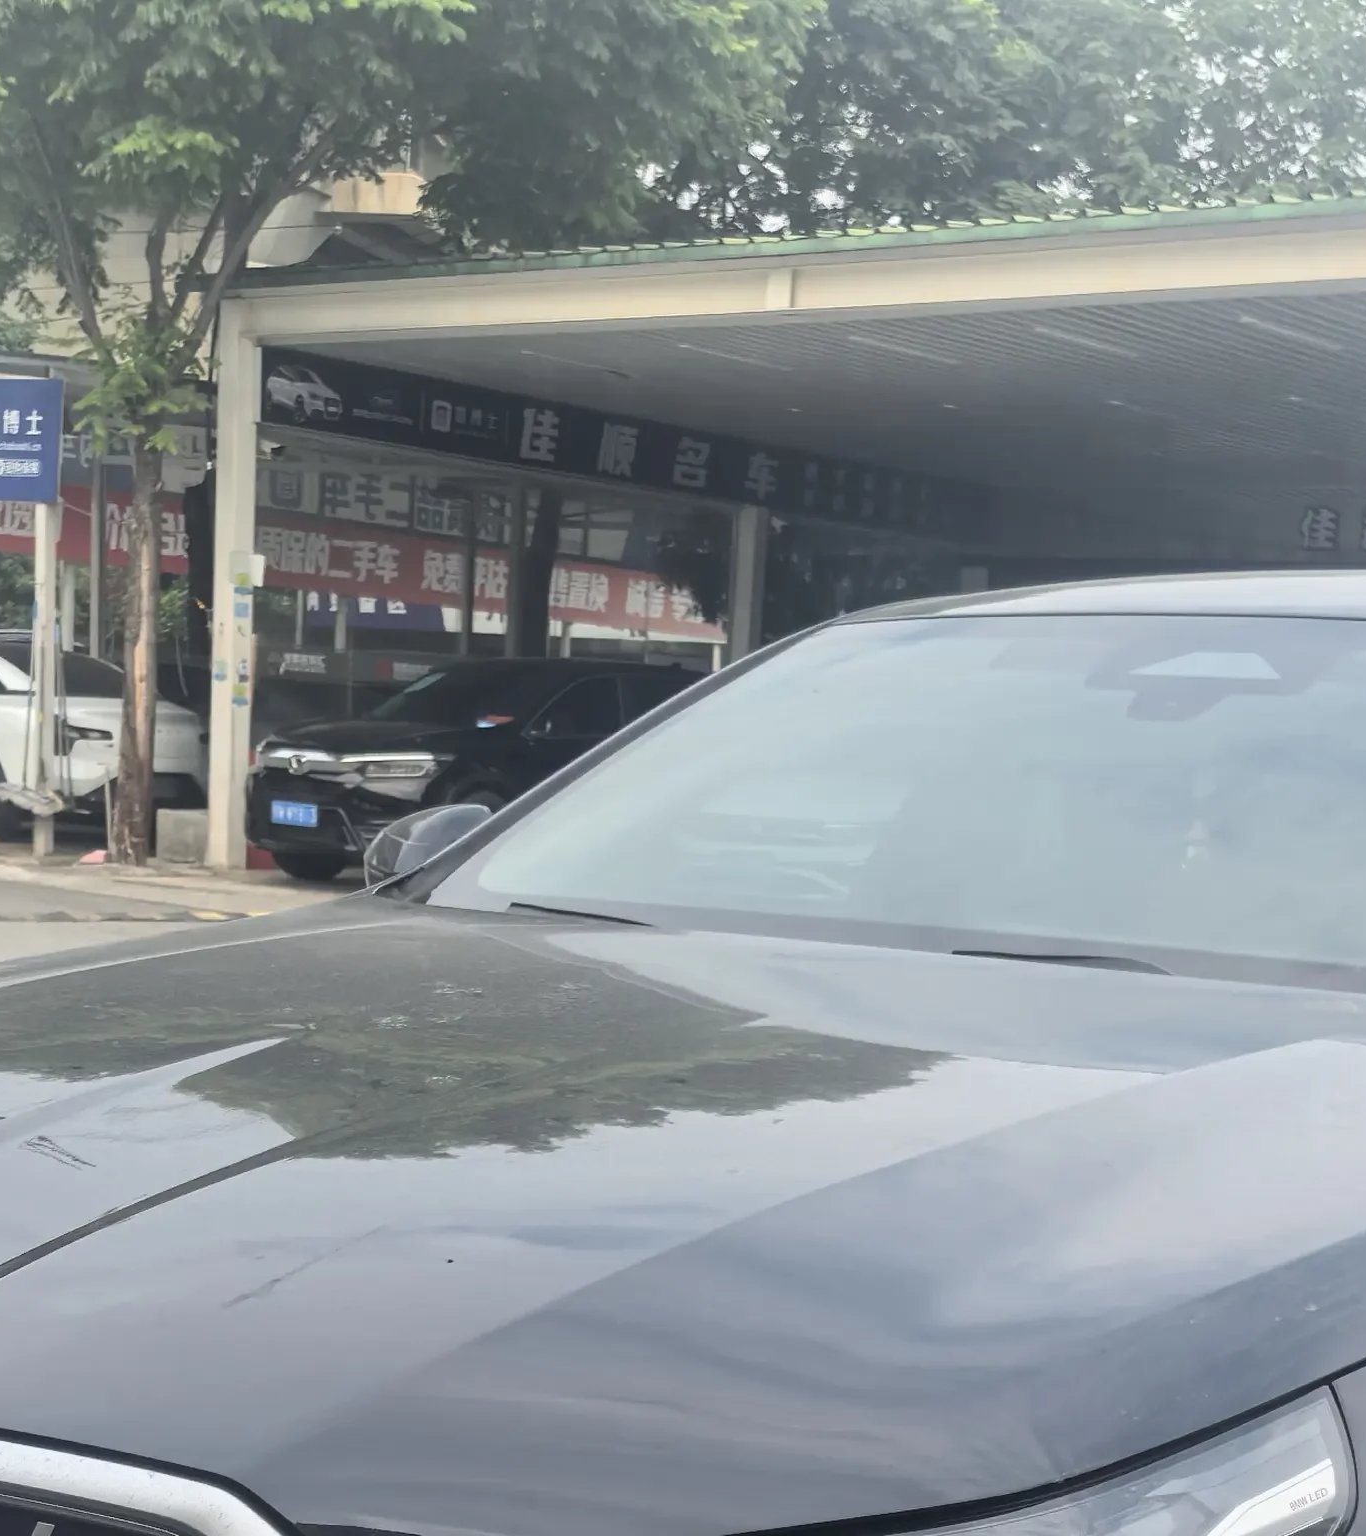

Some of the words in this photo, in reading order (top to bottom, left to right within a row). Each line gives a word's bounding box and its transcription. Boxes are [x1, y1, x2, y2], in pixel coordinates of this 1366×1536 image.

[519, 407, 779, 500] 佳顺名车
[1308, 1487, 1328, 1503] LED
